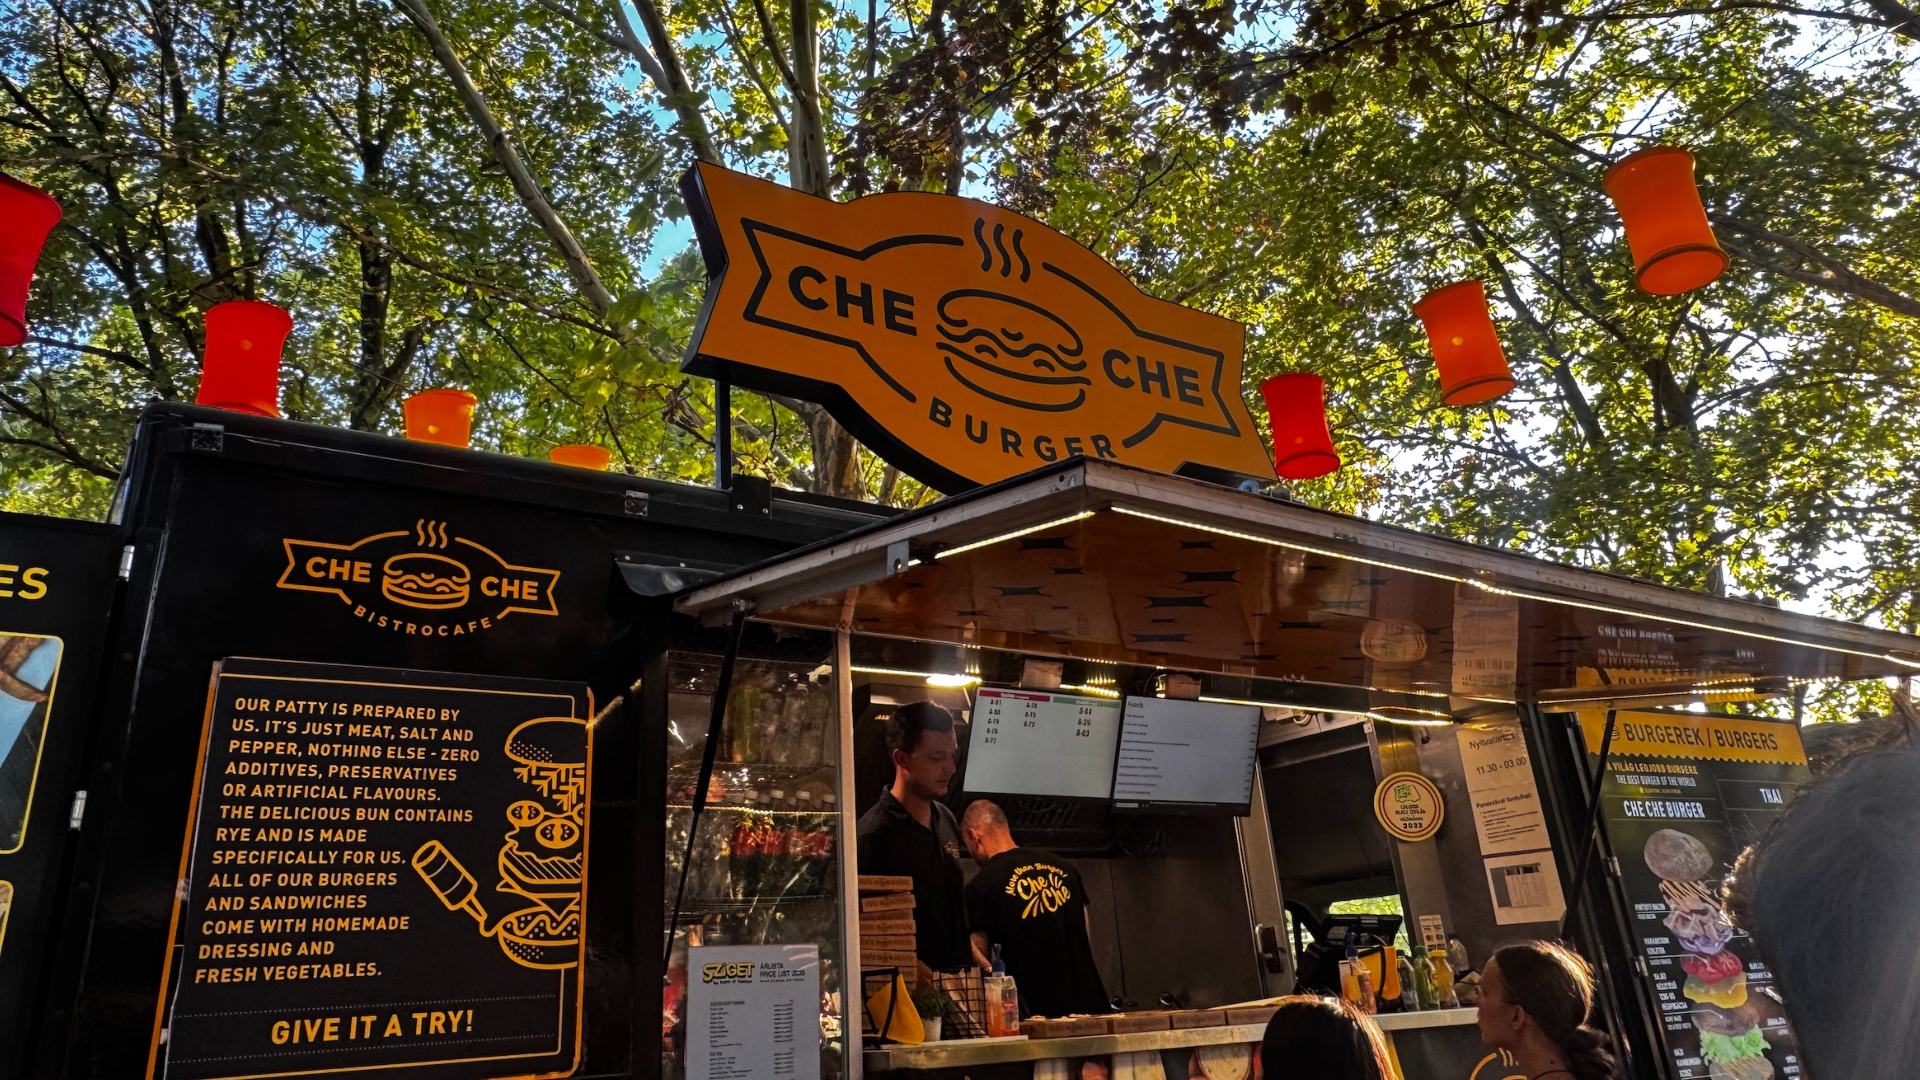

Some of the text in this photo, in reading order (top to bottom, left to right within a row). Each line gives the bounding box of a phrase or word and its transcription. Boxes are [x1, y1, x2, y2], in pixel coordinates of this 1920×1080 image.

[787, 264, 918, 336] CHE
[1102, 347, 1205, 406] CHE
[928, 396, 1118, 463] BURGER
[305, 556, 372, 583] CHE
[480, 576, 539, 601] CHE
[353, 604, 492, 637] BISTROCAFE
[235, 697, 459, 721] OUR PATTY IS PREPARED BY
[232, 719, 473, 742] US. IT'S JUST MEAT, SALT AND
[1622, 723, 1778, 750] BURGEREK / BURGERS
[229, 739, 302, 757] PEPPER,
[307, 743, 382, 758] NOTHING
[386, 746, 425, 760] ELSE
[441, 748, 480, 762] ZERO
[225, 761, 457, 781] ADDITIVES, PRESERVATIVES
[222, 783, 441, 801] OR ARTIFICIAL FLAVOURS.
[1759, 788, 1784, 804] THAI
[221, 805, 473, 823] THE DELICIOUS BUN CONTAINS
[1623, 800, 1706, 818] CHE CHE BURGER
[216, 827, 366, 842] RYE AND IS MADE
[213, 850, 406, 865] SPECIFICALLY FOR US.
[209, 872, 397, 888] ALL OF OUR BURGERS
[1017, 877, 1048, 900] Che
[205, 894, 367, 911] AND SANDWICHES
[1041, 886, 1071, 912] Che
[202, 916, 408, 935] COME WITH HOMEMADE
[198, 940, 335, 960] DRESSING AND
[195, 962, 382, 983] FRESH VEGETABLES.
[271, 1009, 474, 1045] GIVE IT A TRY!
